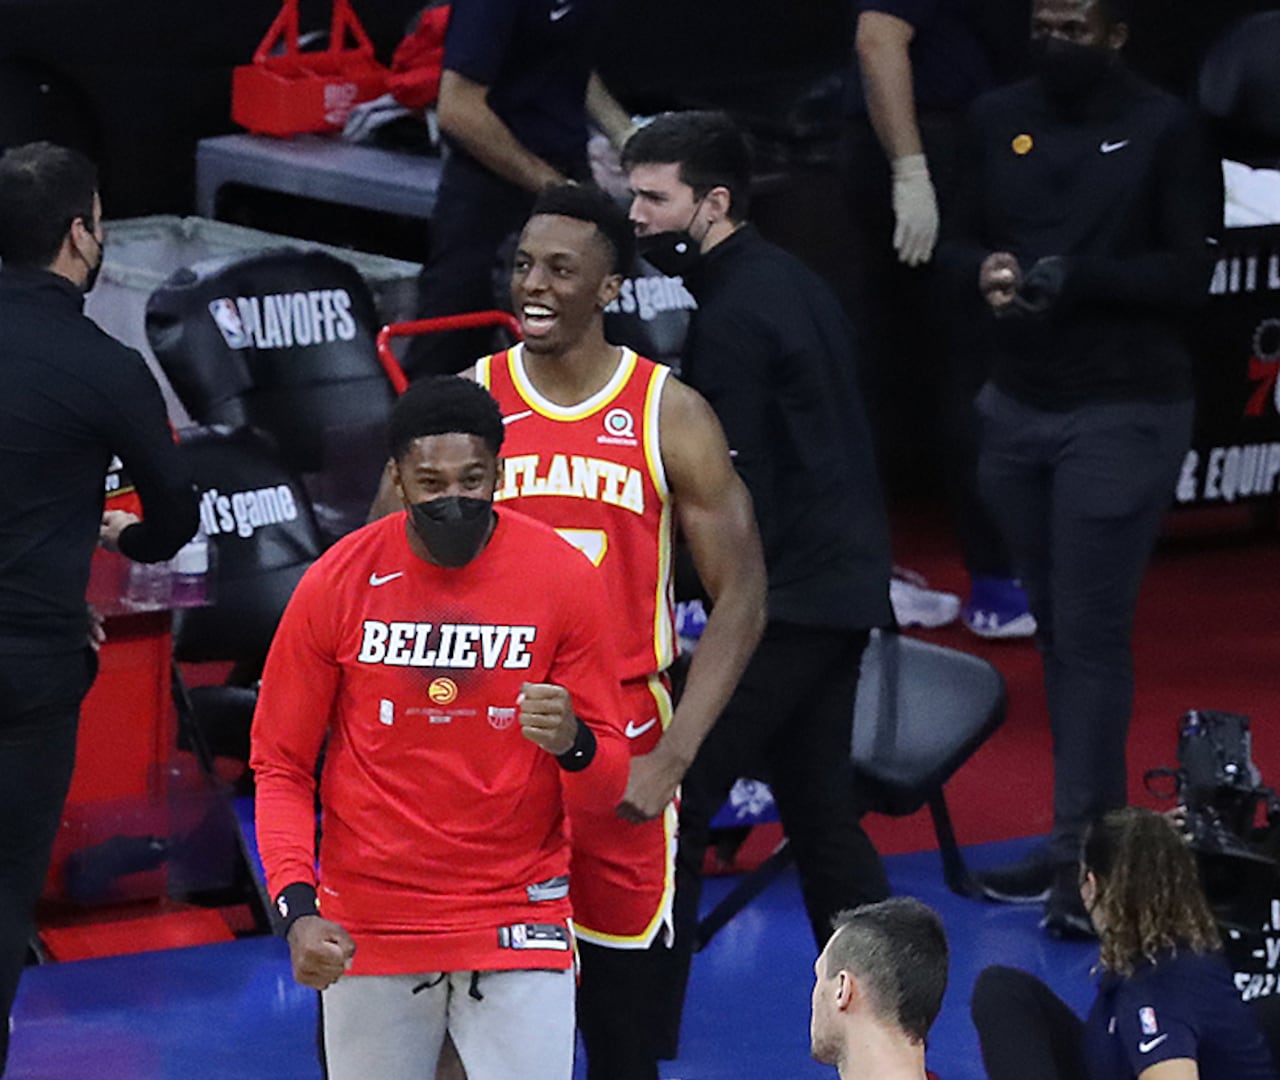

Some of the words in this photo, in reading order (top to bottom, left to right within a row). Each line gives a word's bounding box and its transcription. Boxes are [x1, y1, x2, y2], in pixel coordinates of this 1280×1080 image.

[236, 288, 356, 349] PLAYOFFS
[231, 485, 297, 538] game
[493, 454, 645, 515] TLANTA
[357, 619, 537, 669] BELIEVE
